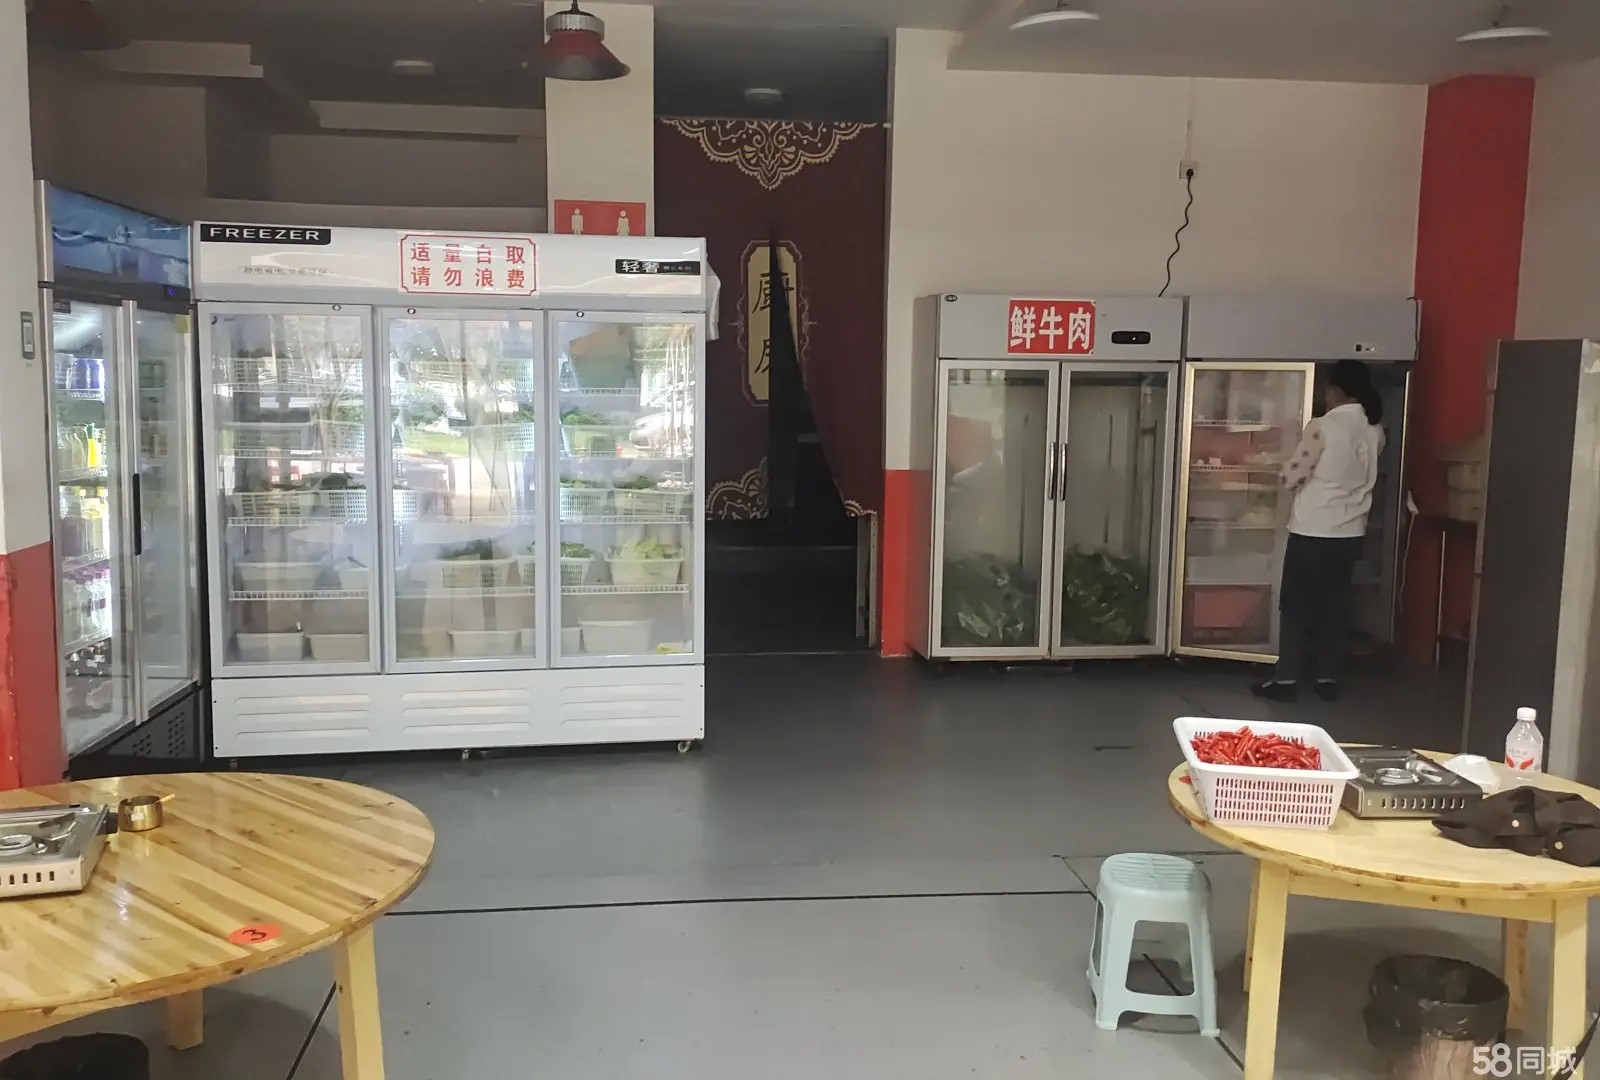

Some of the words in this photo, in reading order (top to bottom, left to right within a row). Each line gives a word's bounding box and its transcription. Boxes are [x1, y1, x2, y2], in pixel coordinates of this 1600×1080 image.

[209, 227, 320, 241] FREEZER
[410, 242, 526, 265] 适量自取
[621, 260, 660, 273] 轻奢
[410, 266, 526, 289] 请勿浪费
[1009, 305, 1092, 350] 鲜牛肉
[241, 928, 267, 941] 3
